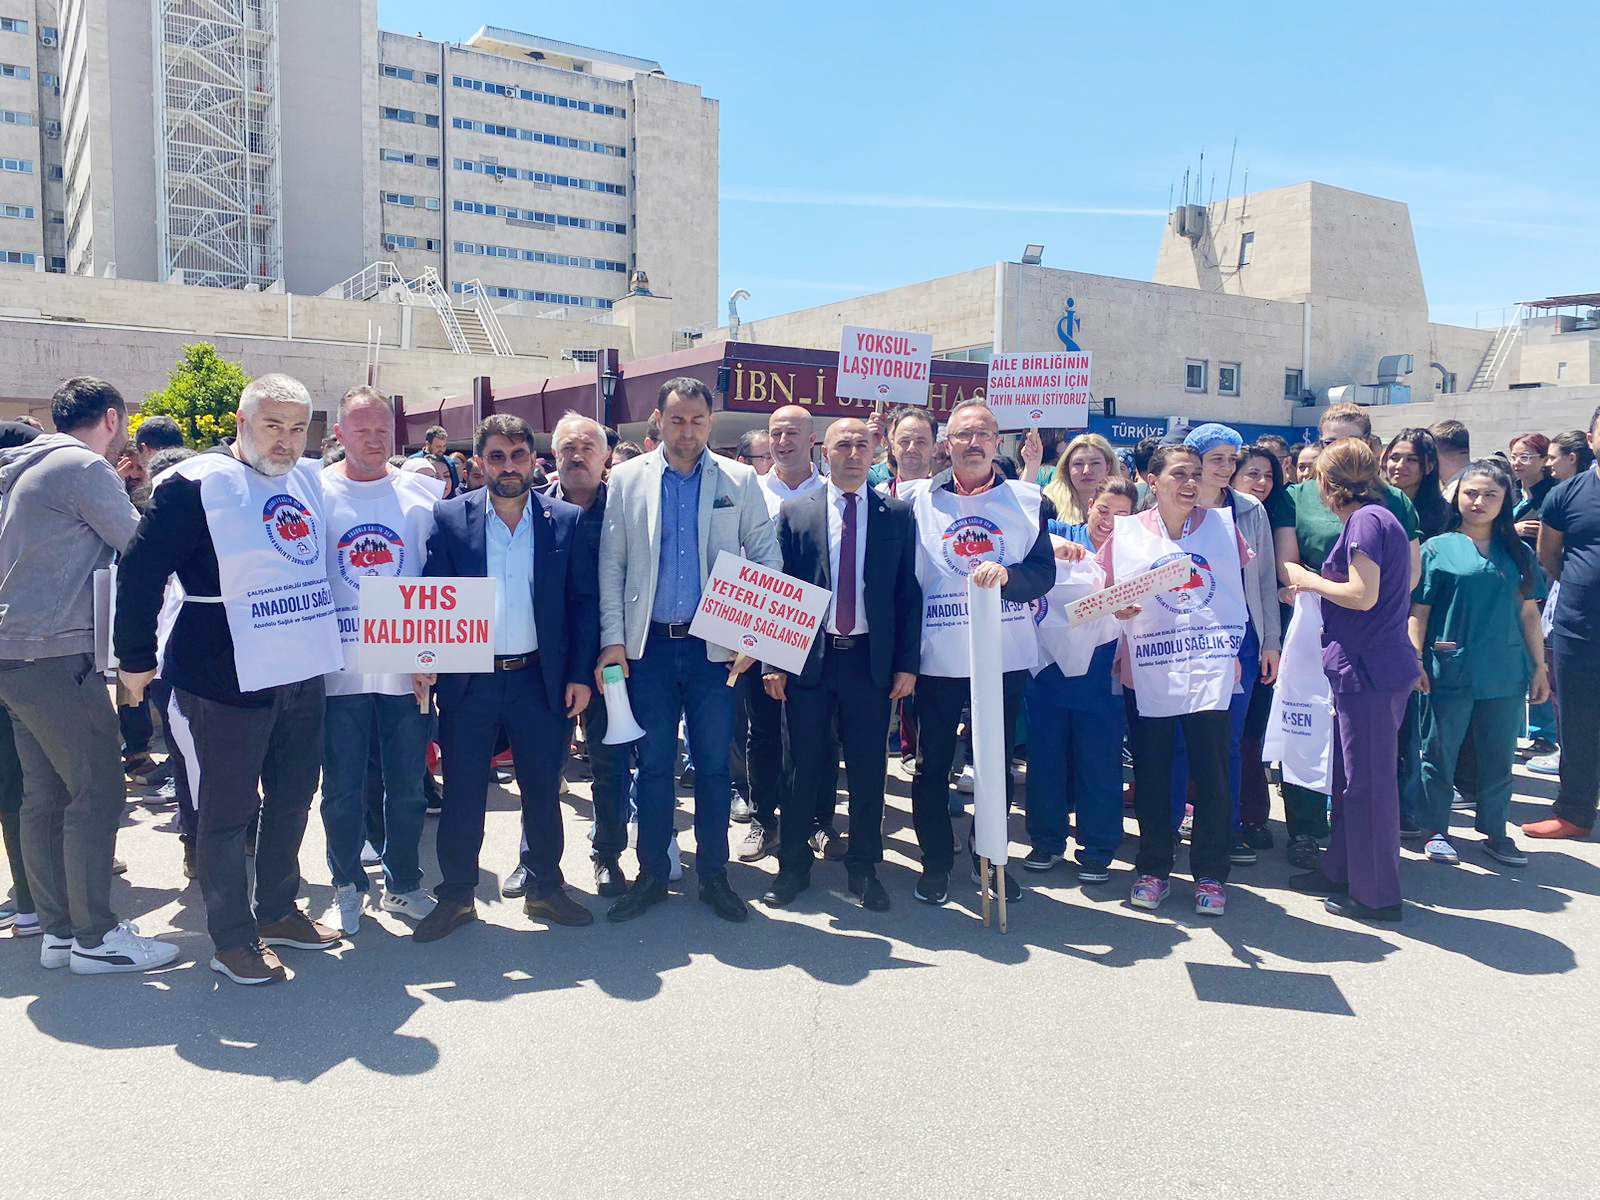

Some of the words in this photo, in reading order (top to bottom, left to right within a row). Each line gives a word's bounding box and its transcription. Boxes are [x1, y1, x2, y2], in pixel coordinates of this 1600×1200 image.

[857, 333, 918, 356] YOKSUL-
[843, 355, 928, 381] LAŞIYORUZ!
[992, 355, 1018, 371] AİLE
[1022, 353, 1089, 370] BİRLİĞİNİN
[990, 373, 1061, 389] SAĞLANMASI
[1065, 371, 1089, 390] İÇİN
[990, 391, 1013, 406] TAYİN
[1015, 393, 1040, 406] HAKKI
[1042, 390, 1087, 405] İSTİYORUZ
[1111, 421, 1165, 439] TÜRKİYE
[738, 566, 804, 603] KAMUDA
[252, 594, 310, 618] ANADOLU
[398, 584, 458, 611] YHS
[711, 577, 769, 611] YETERLİ
[768, 600, 817, 630] SAYIDA
[363, 618, 490, 645] KALDIRILSIN
[701, 594, 753, 629] İSTİHDAM
[753, 616, 811, 651] SAĞLANSIN
[1135, 638, 1183, 658] ANADOLU
